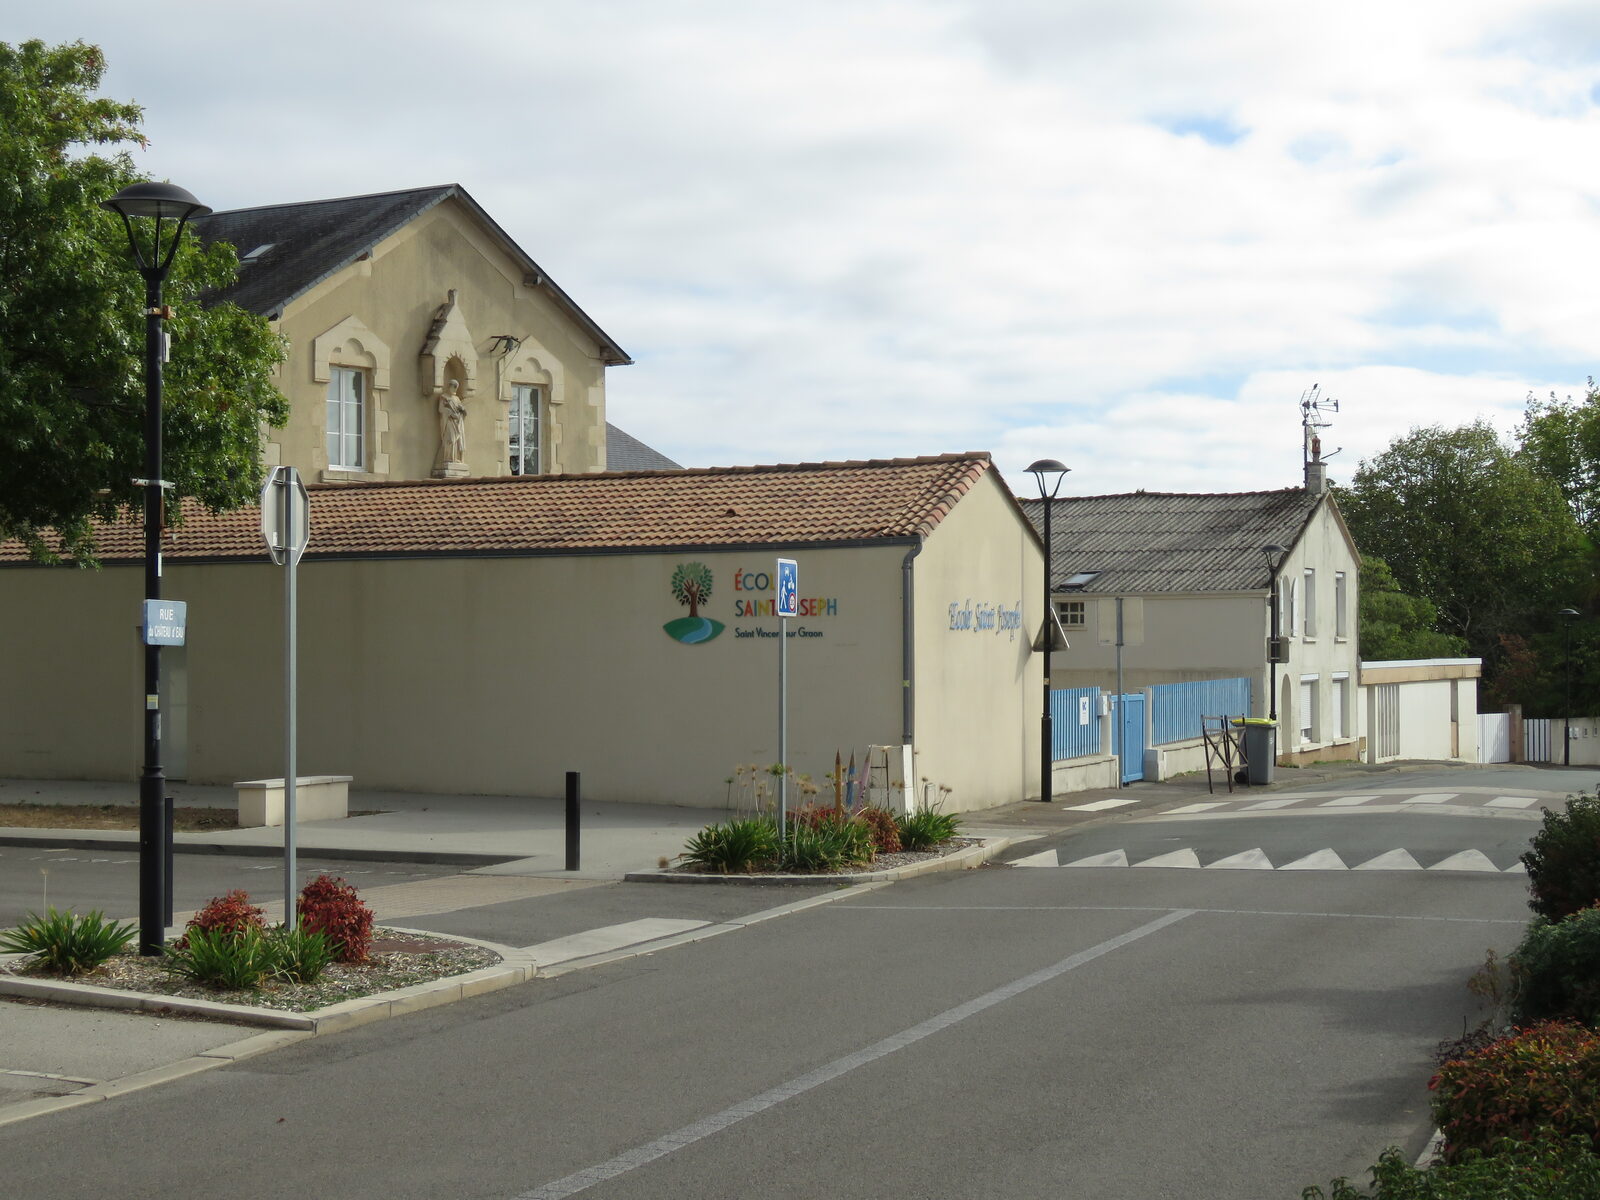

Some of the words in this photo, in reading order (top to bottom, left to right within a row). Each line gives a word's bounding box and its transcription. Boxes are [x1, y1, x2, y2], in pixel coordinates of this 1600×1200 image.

[735, 568, 776, 591] ÉCOL
[159, 608, 174, 620] RUE
[778, 597, 837, 616] SEPH
[974, 601, 995, 632] Saint
[996, 600, 1021, 641] Joseph
[735, 626, 754, 638] Saint
[798, 626, 823, 638] Graon
